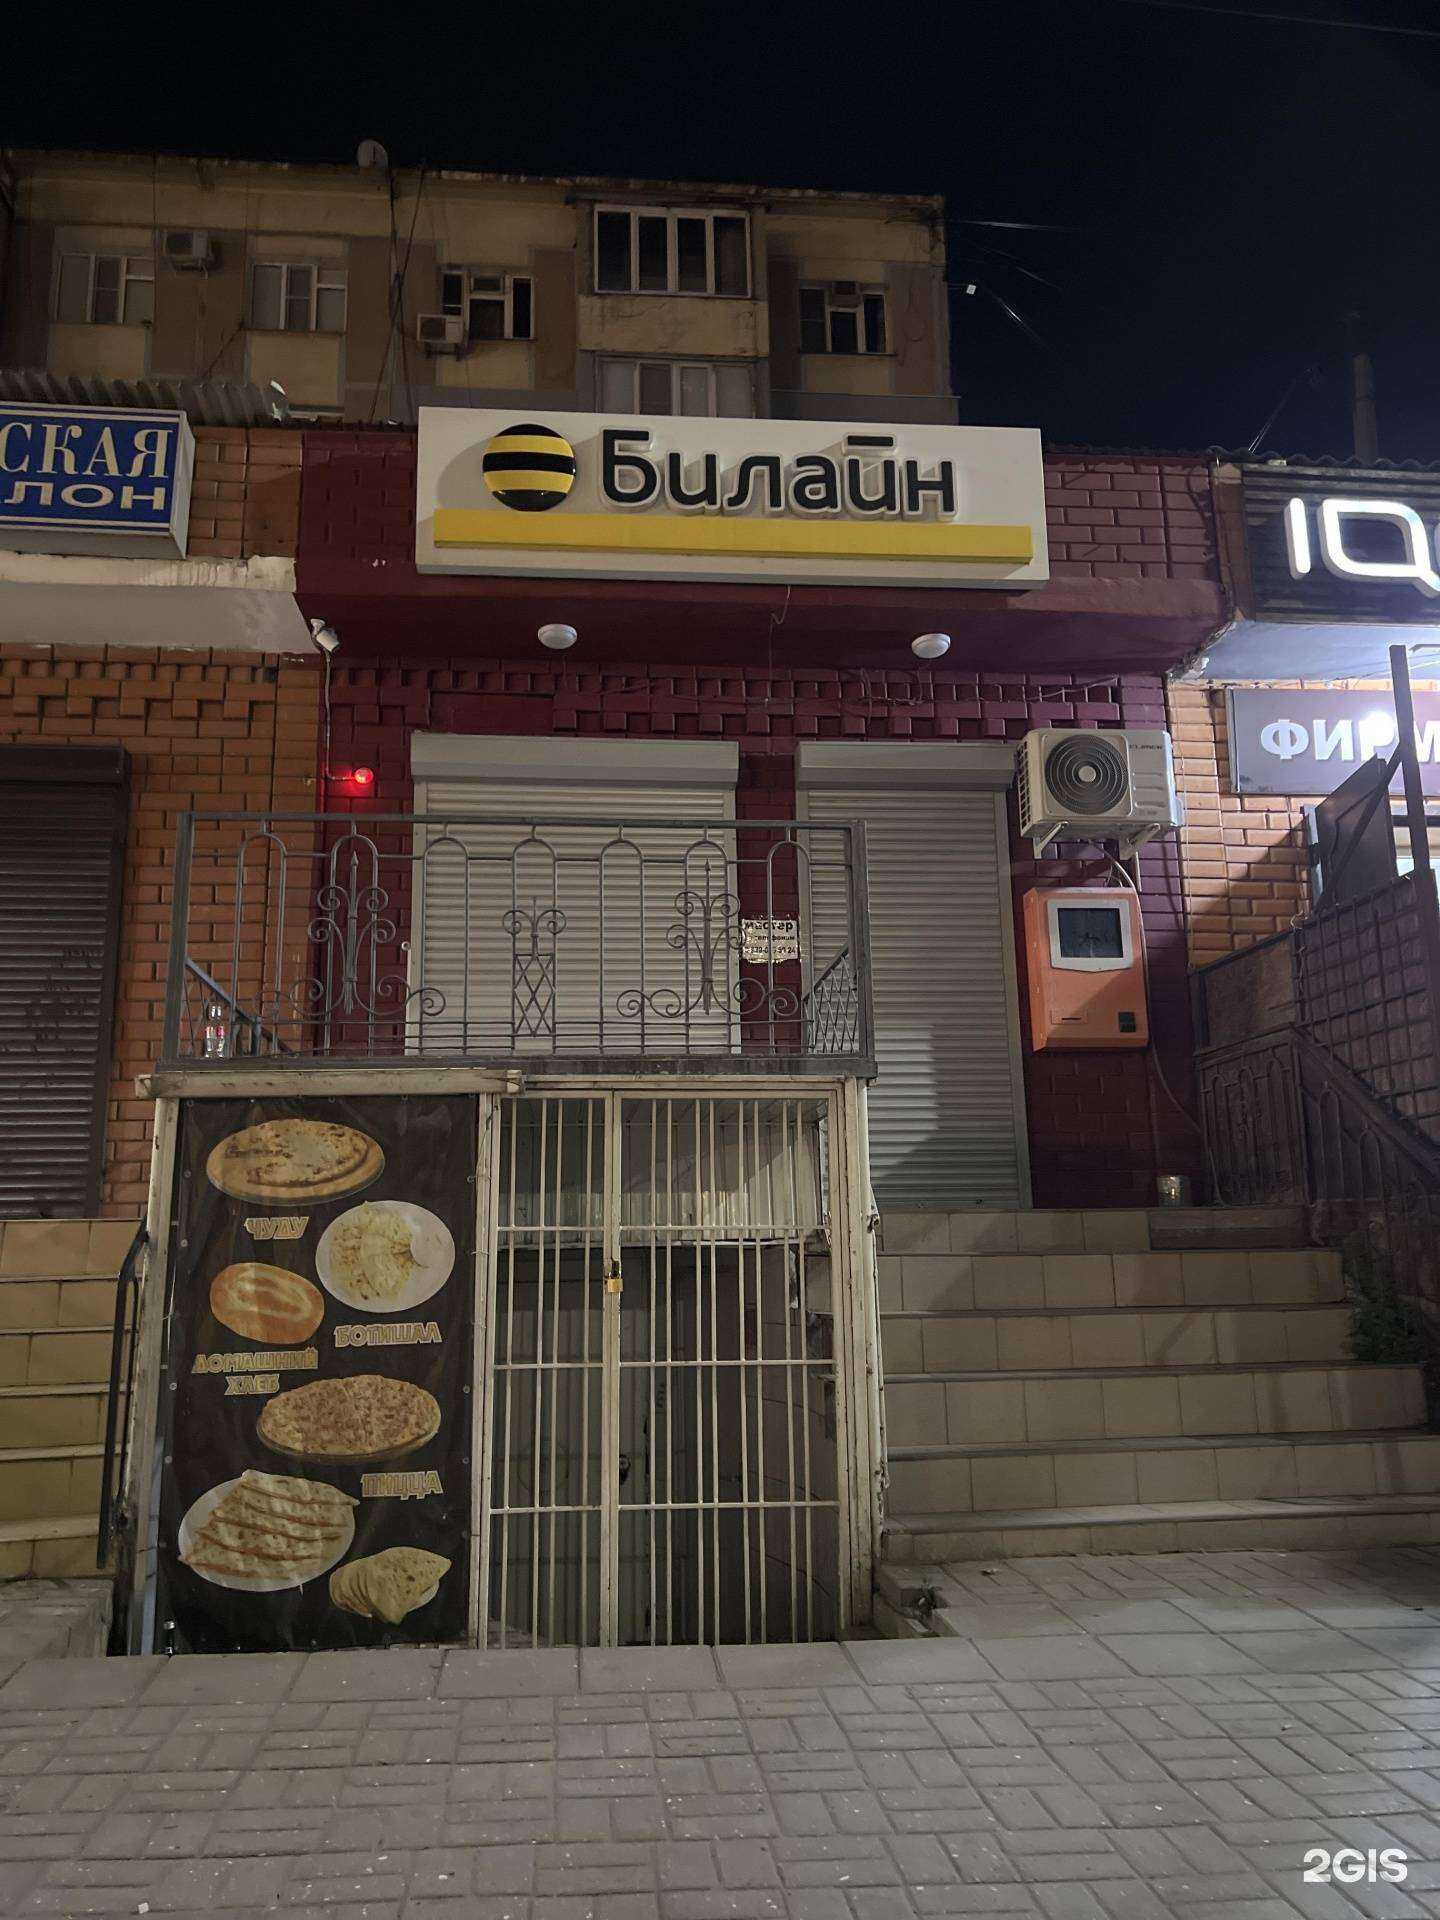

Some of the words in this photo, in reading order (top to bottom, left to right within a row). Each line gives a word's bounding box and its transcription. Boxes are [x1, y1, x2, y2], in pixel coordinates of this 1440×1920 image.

[0, 422, 173, 478] СКАЯ
[601, 428, 956, 515] Билайн
[4, 481, 166, 510] ЛОН
[1284, 497, 1440, 595] IQ
[360, 1471, 443, 1500] ПИЦЦА
